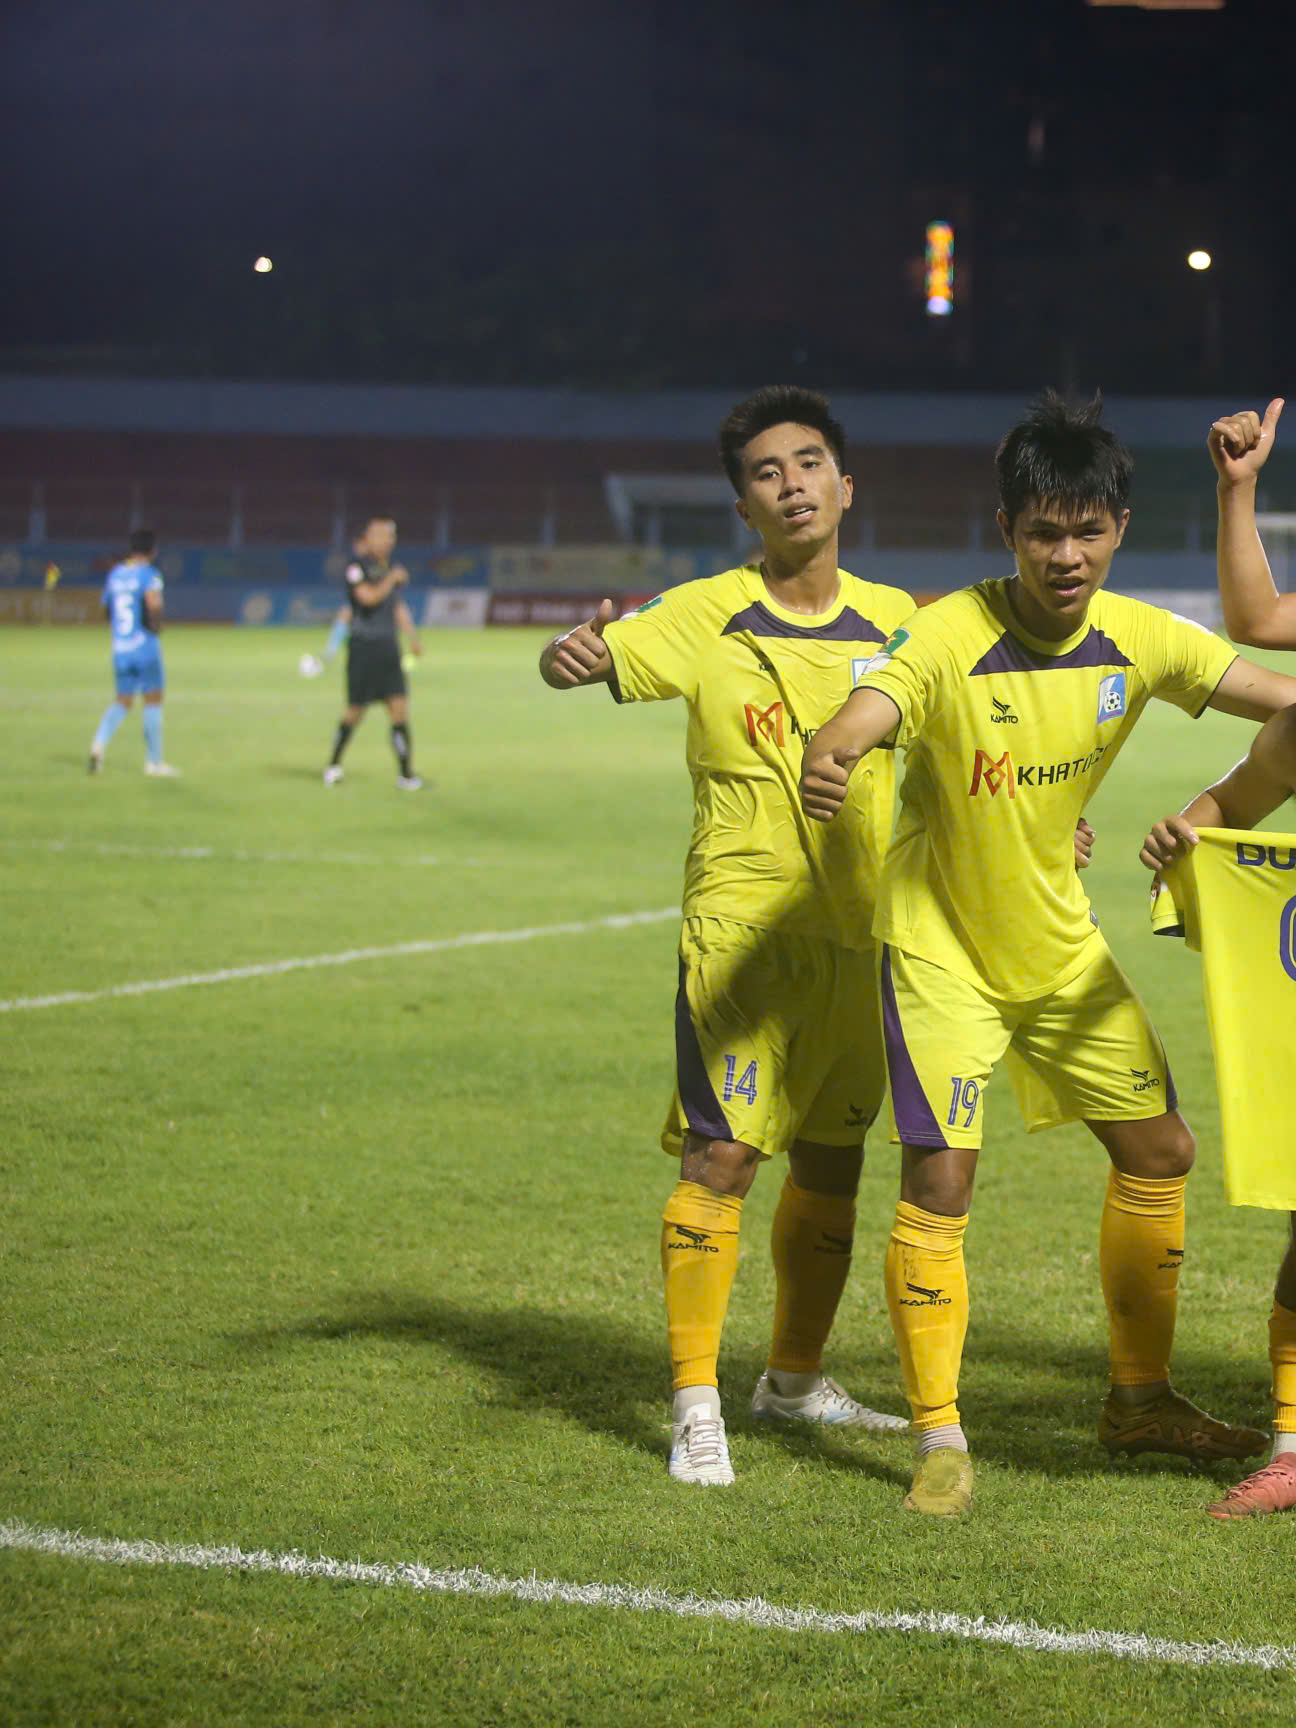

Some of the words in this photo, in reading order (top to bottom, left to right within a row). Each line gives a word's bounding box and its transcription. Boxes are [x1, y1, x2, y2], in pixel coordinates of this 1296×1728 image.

[990, 713, 1019, 724] KAMITO
[723, 1054, 758, 1106] 14
[1132, 1078, 1161, 1093] KAMITO
[947, 1076, 980, 1128] 19
[668, 1242, 720, 1253] KAMITO
[899, 1297, 952, 1307] KAMITO
